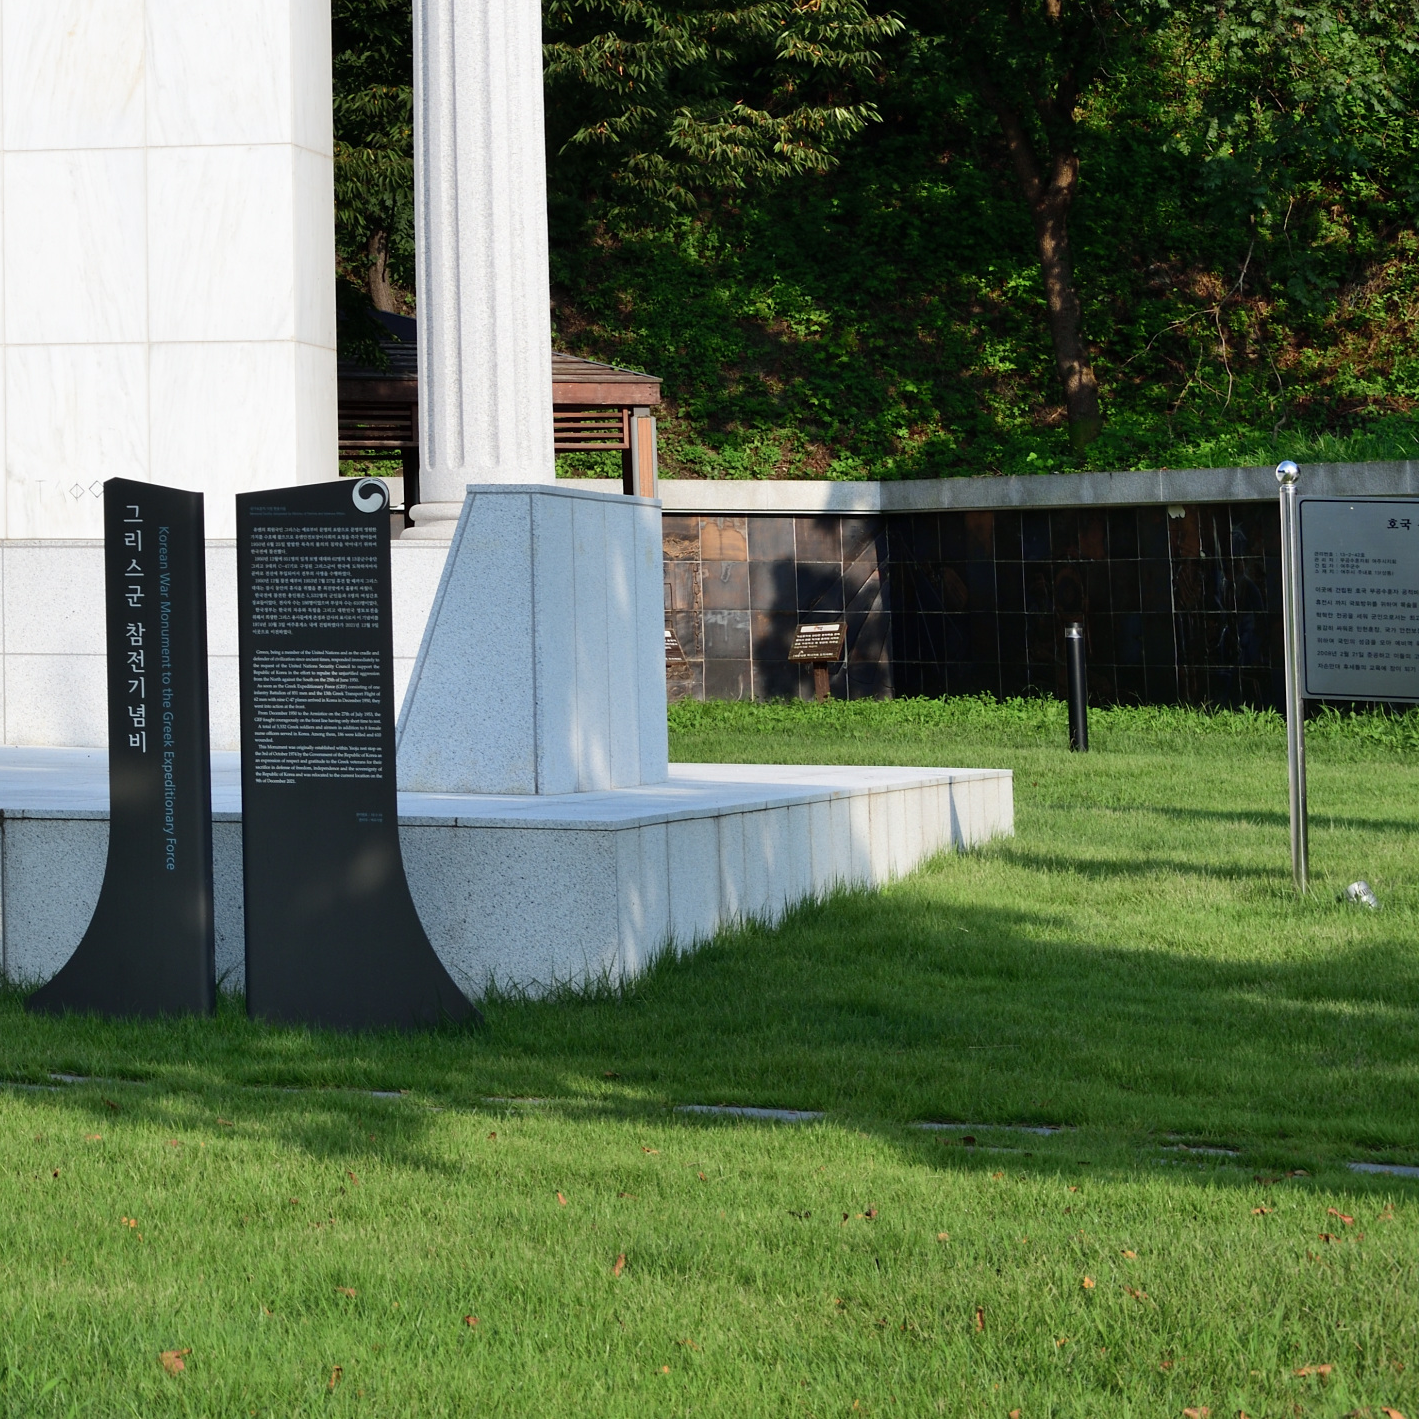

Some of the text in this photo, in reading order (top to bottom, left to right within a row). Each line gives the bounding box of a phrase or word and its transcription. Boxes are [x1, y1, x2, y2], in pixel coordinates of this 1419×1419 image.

[123, 504, 145, 608] 그리스군
[1386, 518, 1412, 531] 호국
[159, 526, 177, 870] Korean War Monument to the Greek Expeditionary Force
